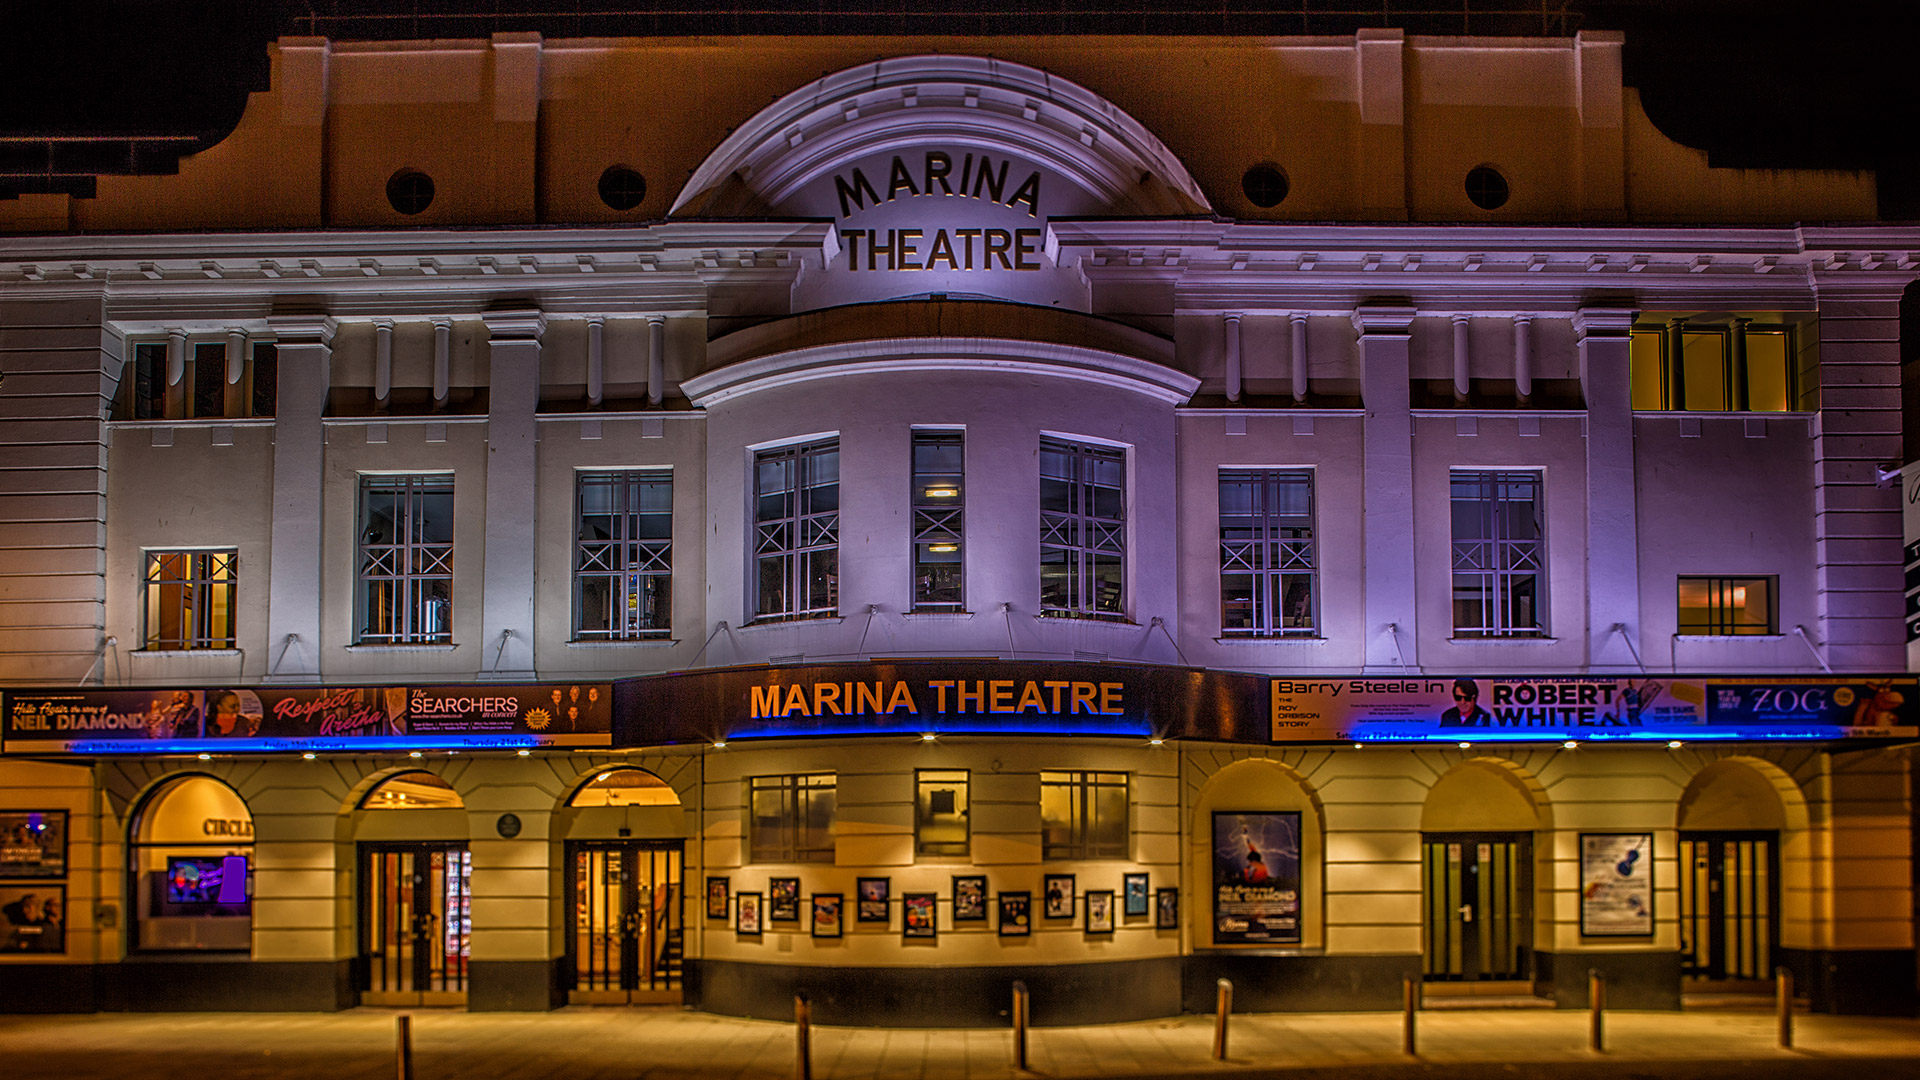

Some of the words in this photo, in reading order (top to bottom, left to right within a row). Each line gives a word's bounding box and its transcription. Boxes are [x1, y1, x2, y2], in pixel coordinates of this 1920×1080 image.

[834, 151, 1041, 218] MARINA
[841, 229, 1041, 271] THEATRE
[411, 689, 427, 698] The
[1278, 682, 1343, 696] Barry
[1349, 681, 1418, 693] Steele
[1425, 681, 1444, 693] in
[1494, 684, 1617, 705] ROBERT
[13, 702, 37, 715] Hello
[273, 688, 356, 723] Respect
[410, 697, 518, 713] SEARCHERS
[751, 682, 917, 718] MARINA
[929, 680, 1124, 715] THEATRE
[1751, 689, 1829, 712] ZOG
[12, 715, 51, 731] NEIL
[56, 712, 145, 730] DIAMOND
[319, 705, 384, 736] Aretha
[1493, 707, 1596, 726] WHITE
[520, 737, 555, 747] February
[204, 819, 253, 836] CIRCLE
